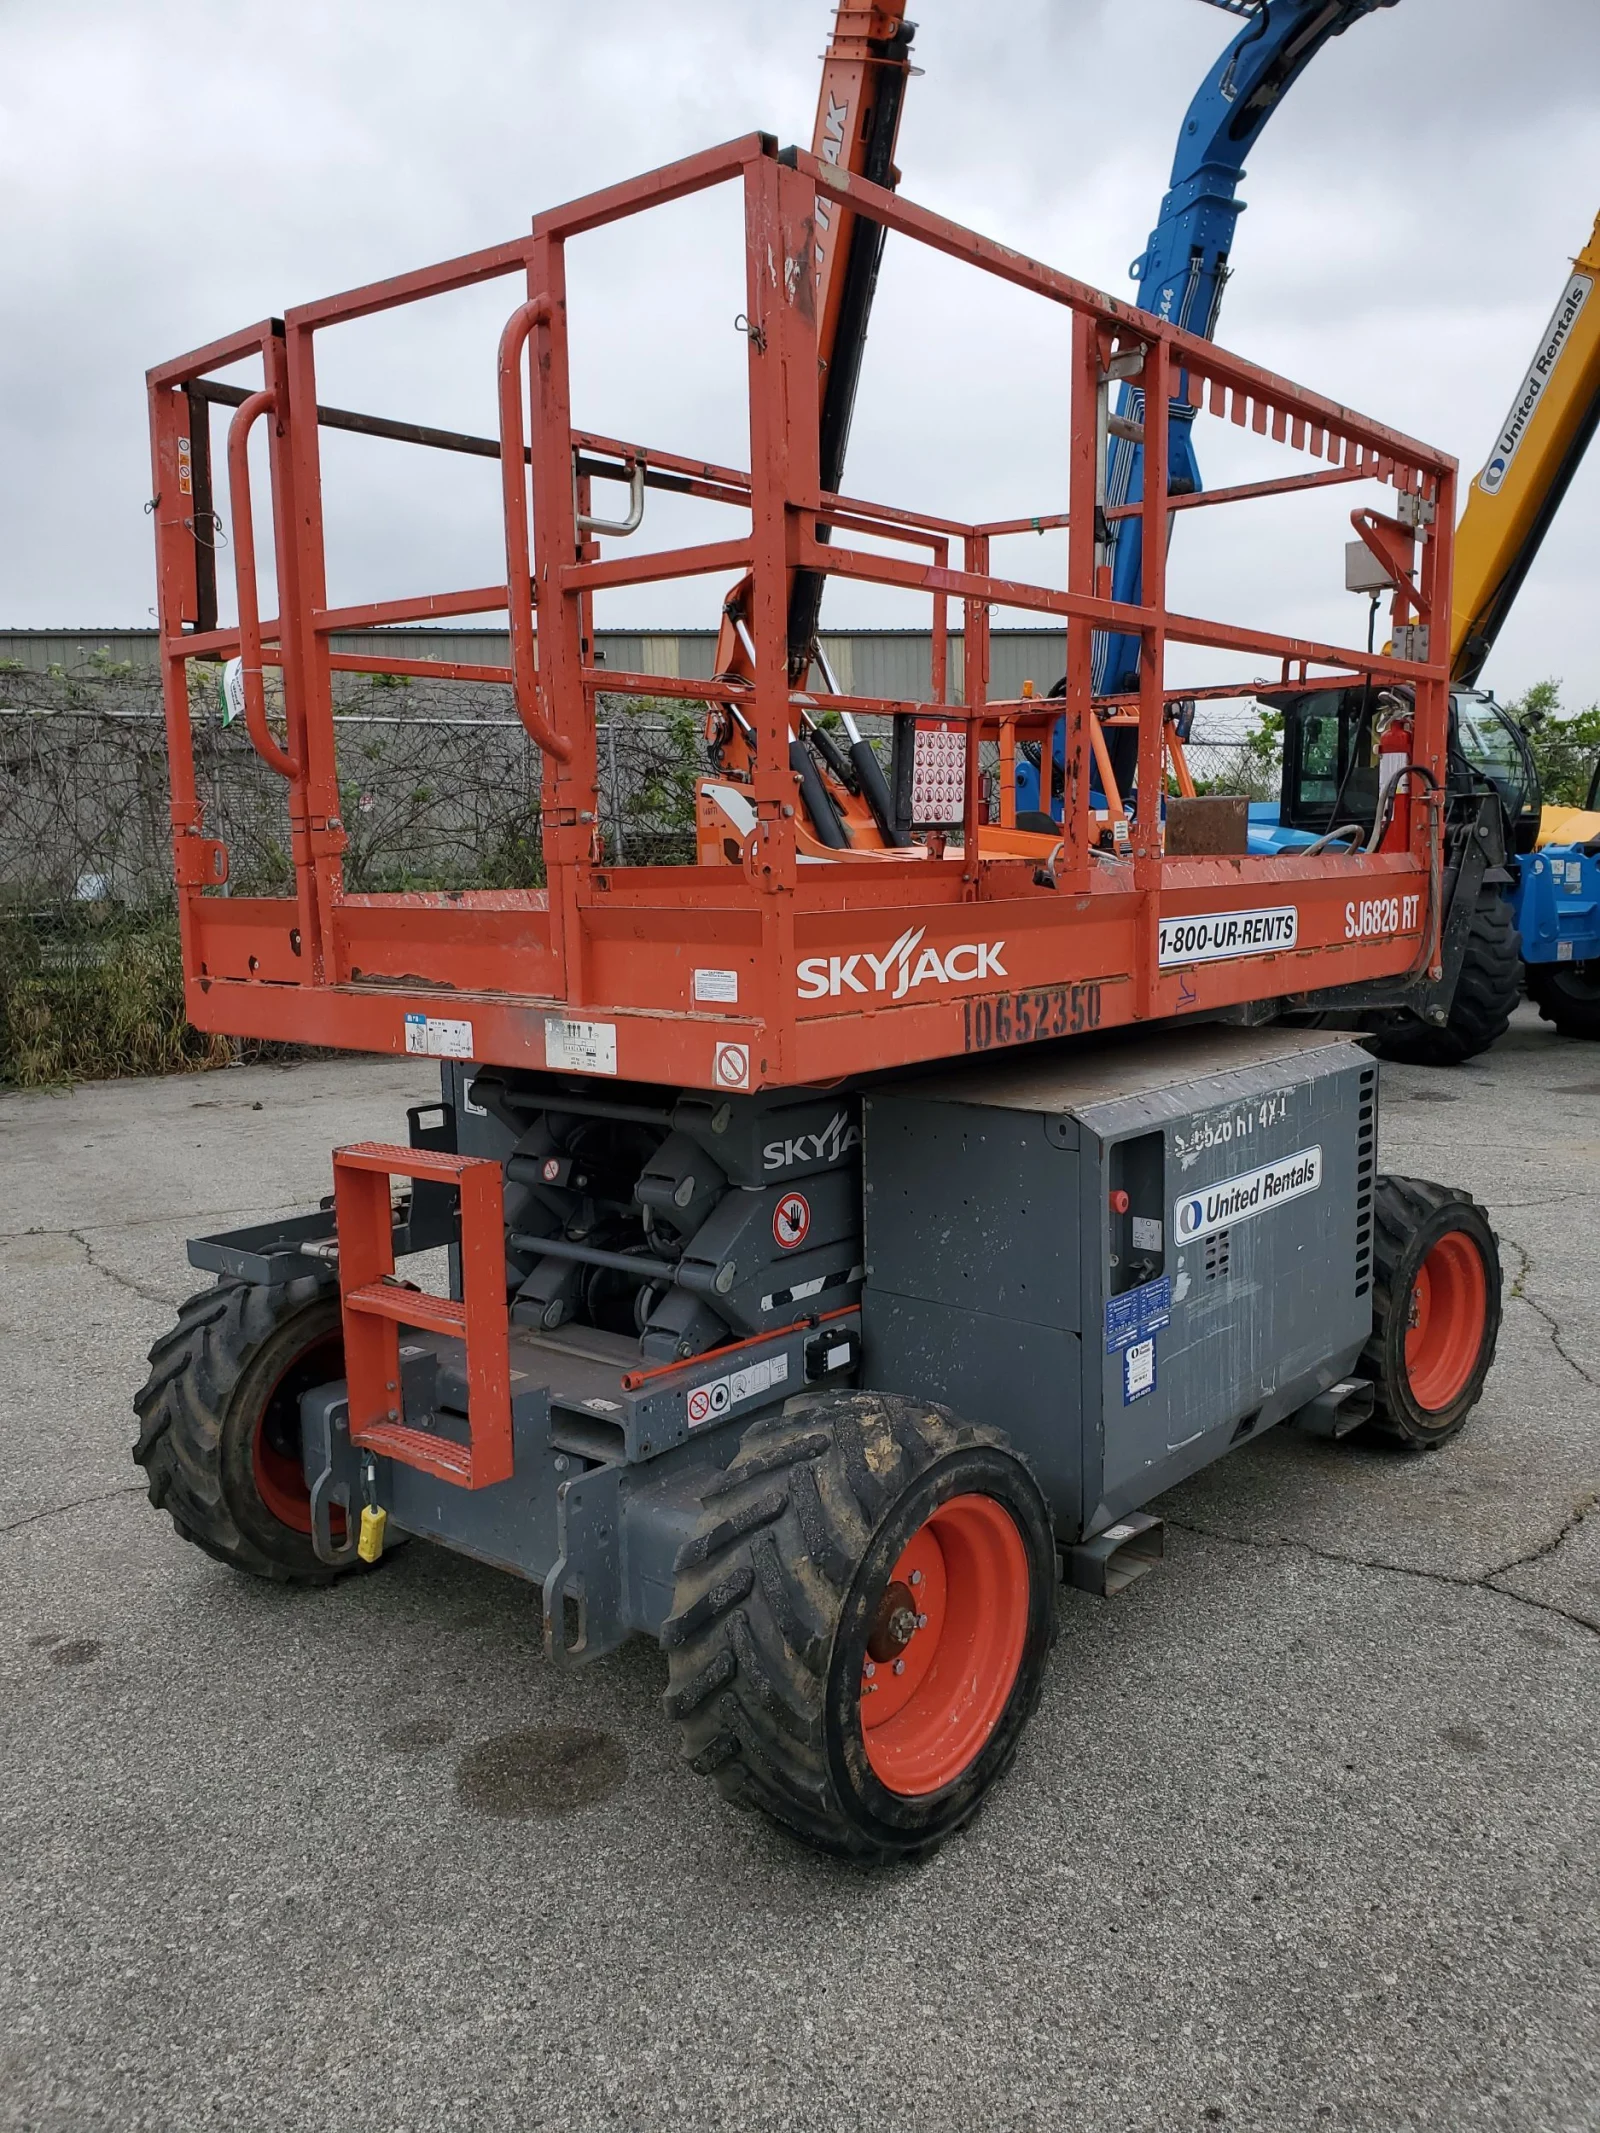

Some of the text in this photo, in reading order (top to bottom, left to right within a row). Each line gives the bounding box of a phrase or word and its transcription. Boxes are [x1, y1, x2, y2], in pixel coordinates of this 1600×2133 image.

[1499, 287, 1584, 455] United Rentals
[1159, 915, 1294, 955] 1-800-UR-RENTS
[1345, 894, 1420, 939] SJ6826 RT
[796, 925, 1009, 999] SKYJACK
[964, 984, 1101, 1052] 10652350
[1206, 1158, 1315, 1223] United Rentals
